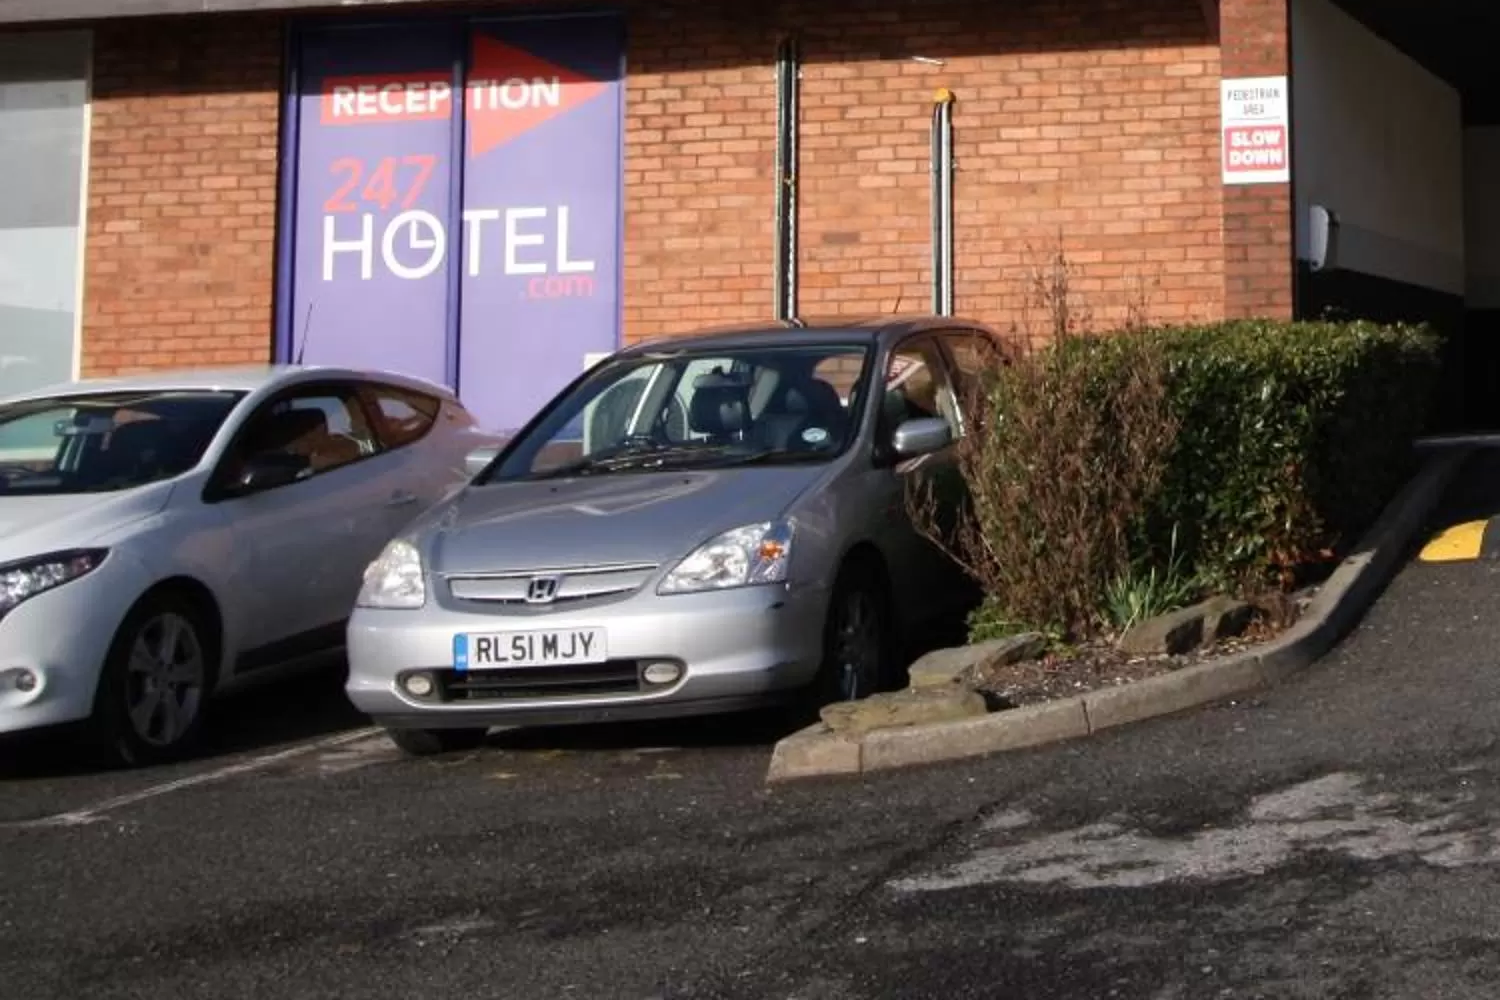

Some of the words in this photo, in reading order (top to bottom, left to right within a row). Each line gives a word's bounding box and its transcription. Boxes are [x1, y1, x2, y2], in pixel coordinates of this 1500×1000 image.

[332, 76, 560, 118] RECEPTION
[1231, 129, 1281, 147] SLOW
[1229, 149, 1284, 167] DOWN
[323, 154, 441, 213] 247
[322, 205, 595, 282] HOTEL
[521, 274, 594, 300] .com
[477, 634, 534, 663] RL51
[542, 631, 594, 660] MJY
